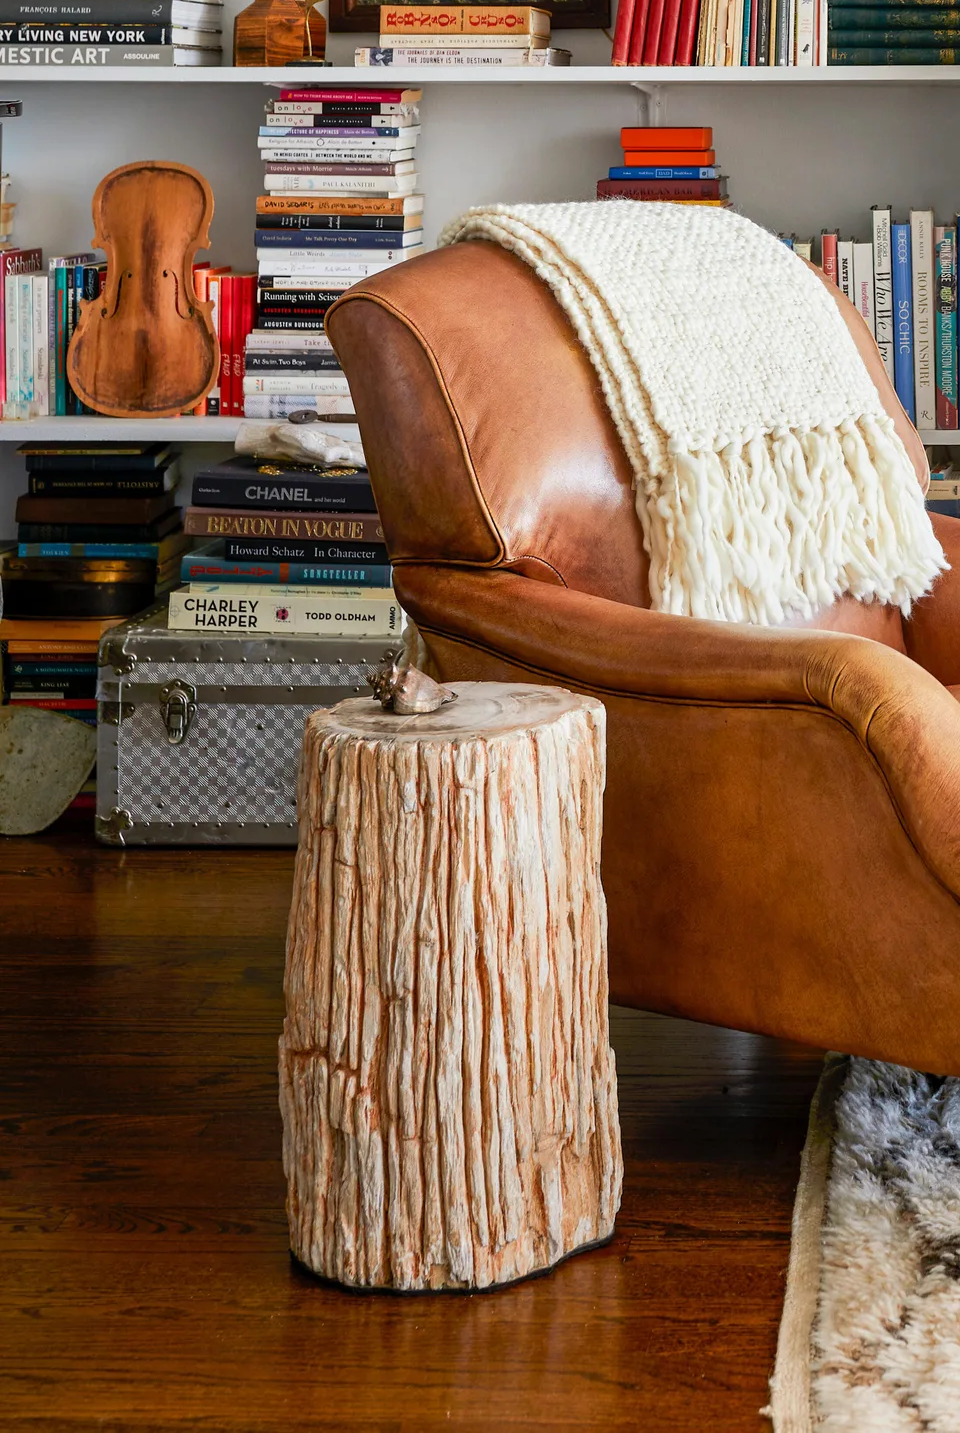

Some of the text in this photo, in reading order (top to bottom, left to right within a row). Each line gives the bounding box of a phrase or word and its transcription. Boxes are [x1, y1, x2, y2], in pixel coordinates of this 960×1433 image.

[386, 12, 525, 28] ROBINSON CRUSOE
[18, 30, 64, 41] LIVING
[70, 30, 101, 41] NEW
[107, 31, 145, 41] YORK
[71, 48, 110, 63] ART
[941, 239, 951, 282] PUNK HOUSE
[876, 272, 890, 305] Who
[264, 292, 342, 303] Running with Scisso
[877, 310, 892, 330] We
[898, 300, 910, 354] SO CHIC
[917, 272, 929, 387] ROOMS TO INSPIRE
[942, 371, 952, 395] MOORE
[245, 486, 312, 502] CHANEL
[207, 516, 364, 539] BEATON IN VOGUE
[230, 545, 376, 559] Howard Schatz In Character
[303, 569, 365, 580] SONGTELLER
[184, 599, 259, 613] CHARLEY
[195, 614, 258, 628] HARPER
[305, 612, 376, 622] TODD OLDHAM
